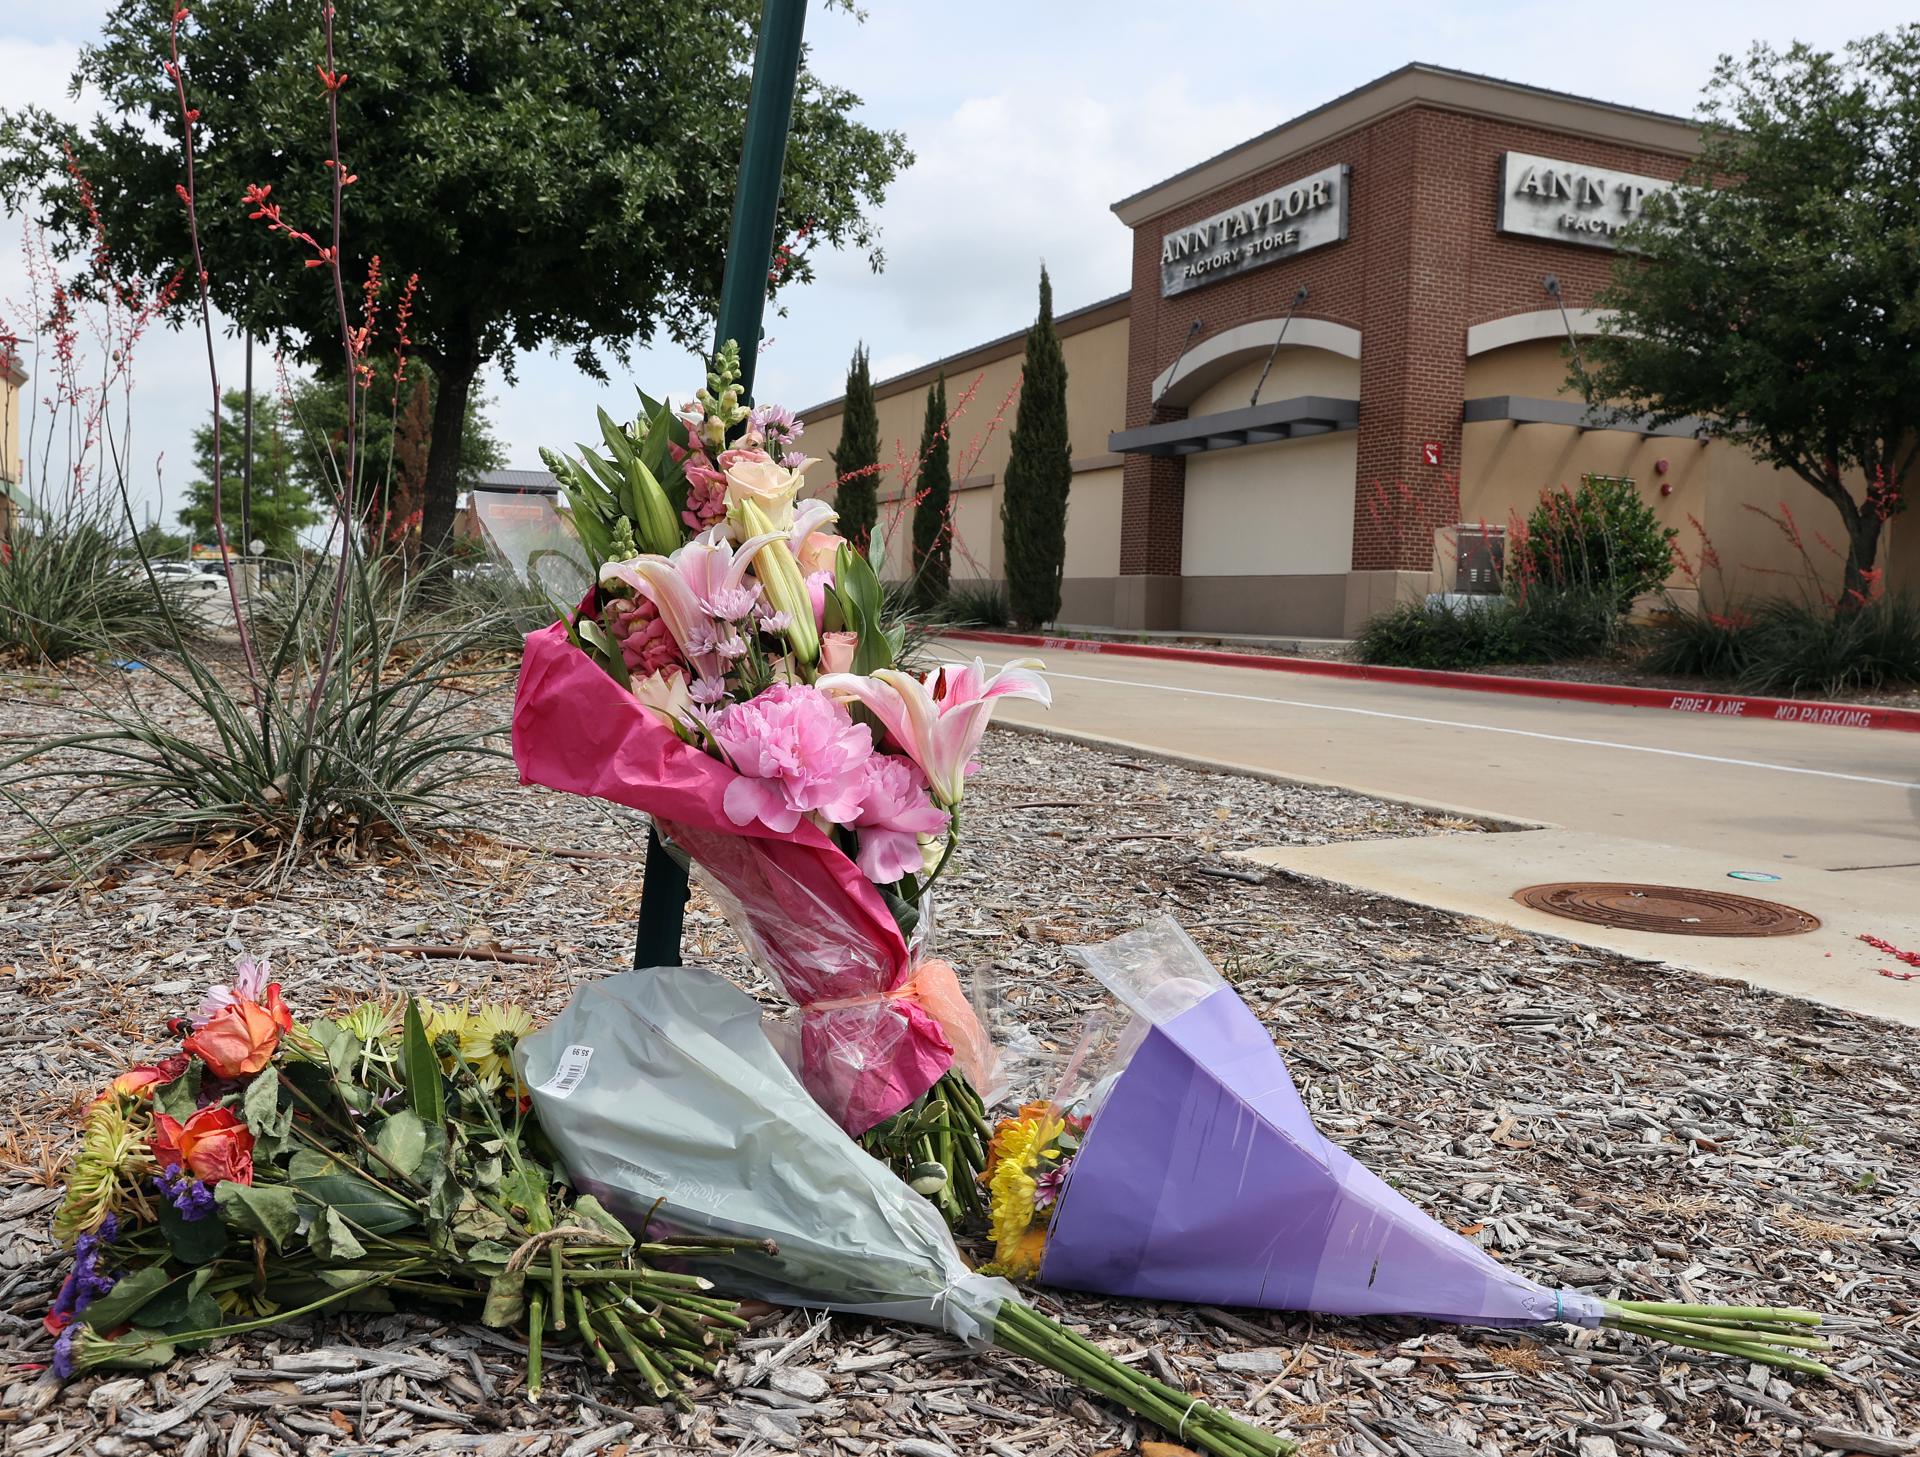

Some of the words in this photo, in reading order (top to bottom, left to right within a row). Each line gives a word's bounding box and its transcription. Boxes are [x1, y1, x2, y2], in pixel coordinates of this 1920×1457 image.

[1519, 164, 1605, 206] ANN
[1160, 222, 1213, 265] ANN
[1218, 179, 1330, 242] TAYLOR
[1564, 213, 1645, 237] FACTO
[1184, 247, 1240, 279] FACTORY
[1246, 228, 1296, 257] STORE
[1670, 696, 1704, 712] FIRE
[1704, 699, 1746, 717] LANE
[1774, 705, 1798, 720] NO
[1799, 706, 1872, 728] PARKING
